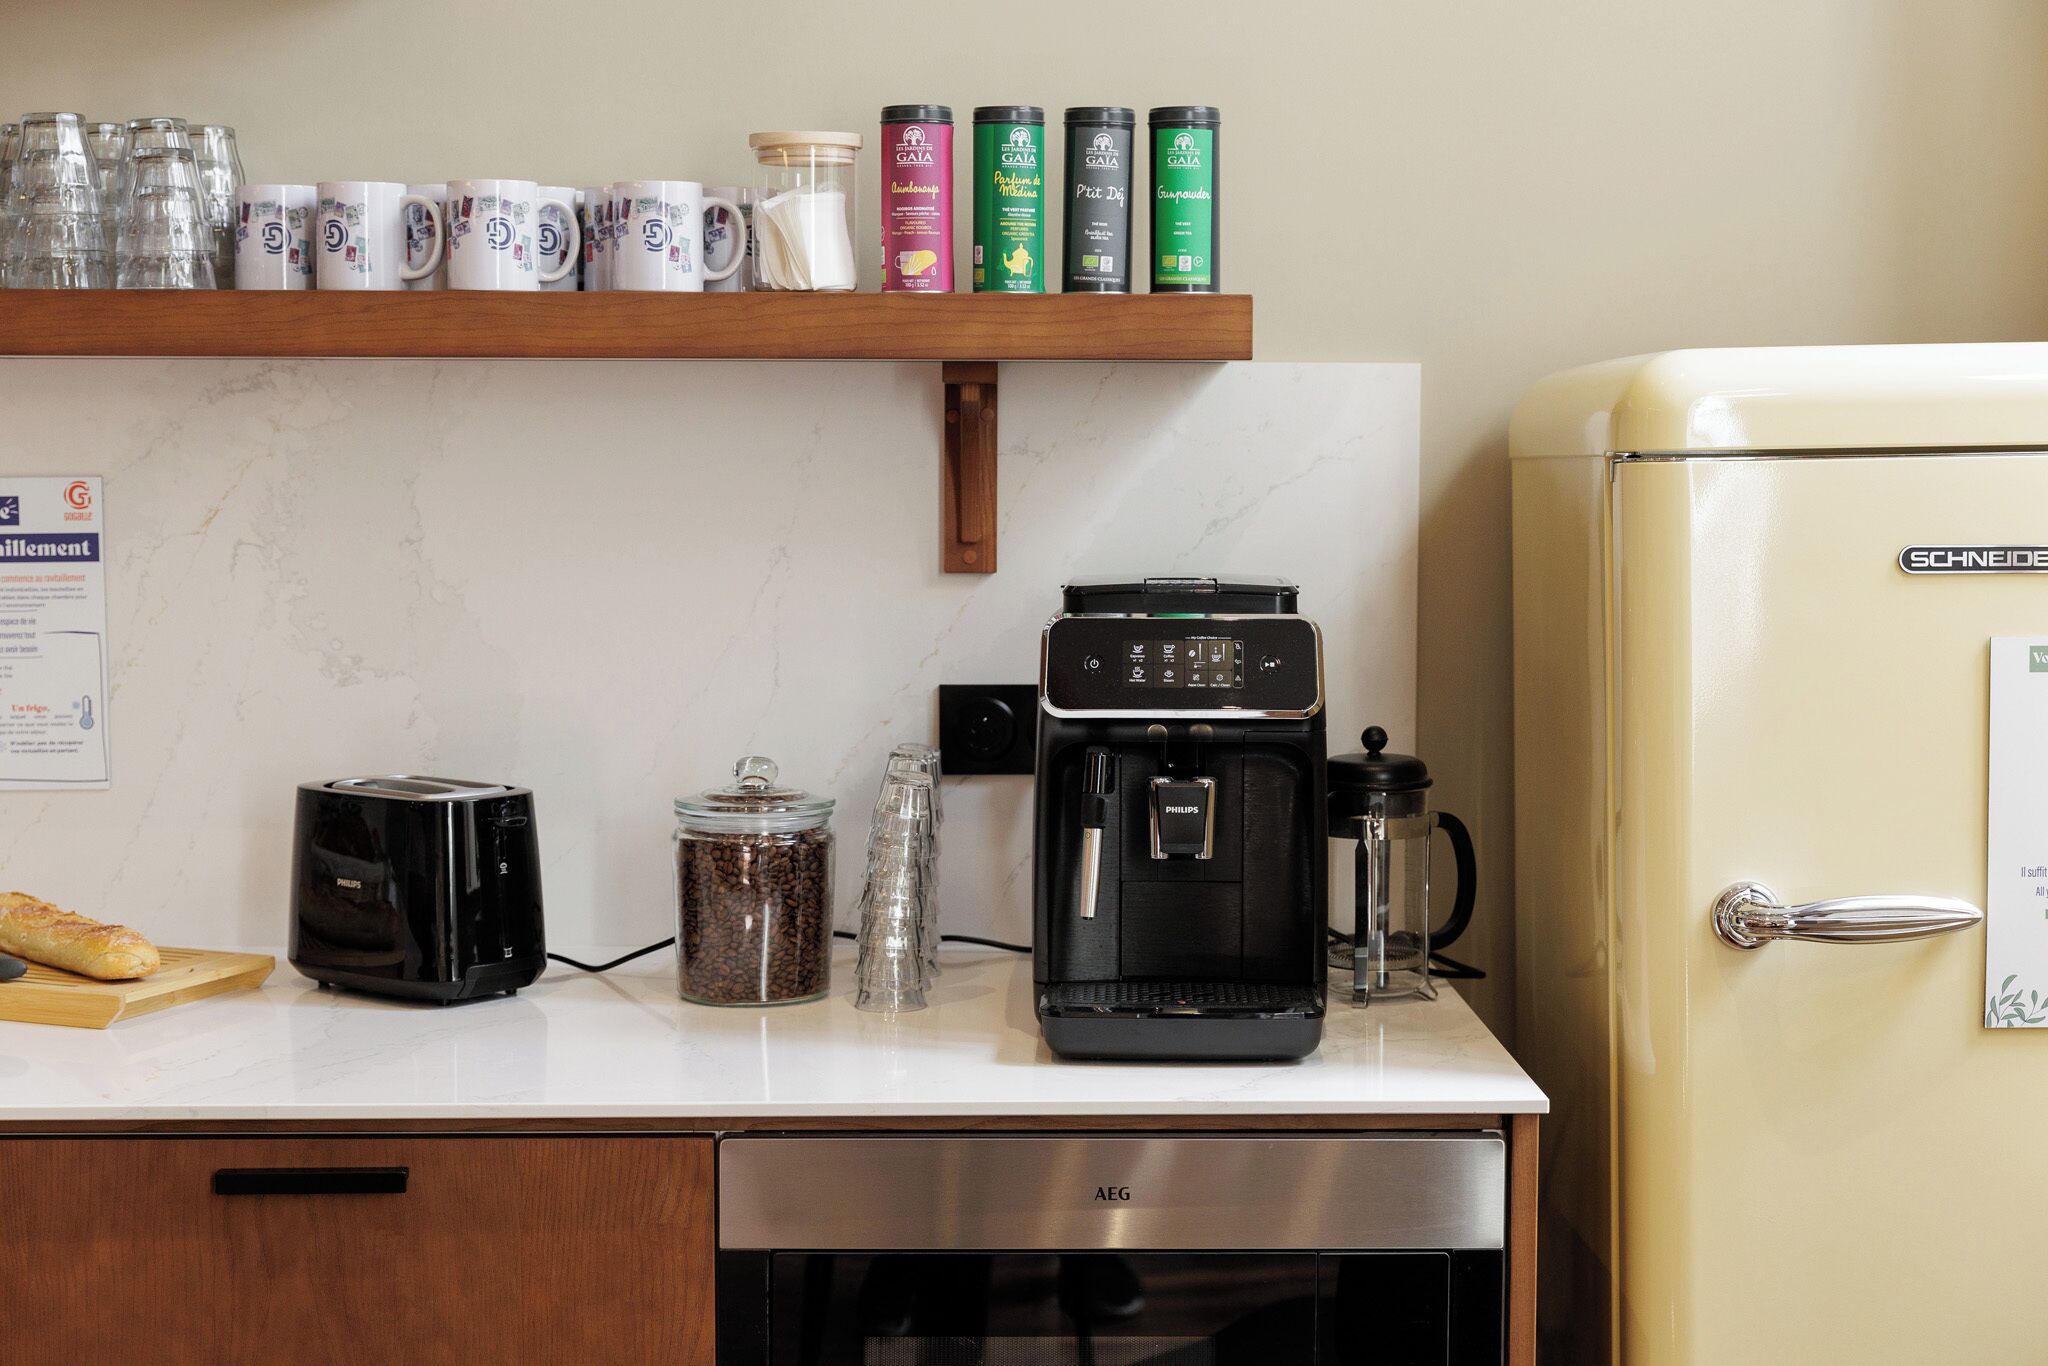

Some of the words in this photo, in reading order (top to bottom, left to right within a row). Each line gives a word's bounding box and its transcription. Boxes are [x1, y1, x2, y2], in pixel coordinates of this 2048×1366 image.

[896, 151, 933, 161] GAÏA
[1001, 152, 1037, 163] GAÏA
[1085, 154, 1118, 166] GAÏA
[1167, 154, 1200, 165] GAÏA
[994, 170, 1032, 188] Parfum
[1033, 173, 1041, 186] de
[999, 183, 1038, 198] Médina
[1076, 183, 1103, 199] P'tit
[1106, 186, 1125, 208] Déj
[1157, 185, 1211, 205] Gunpowder
[1165, 806, 1199, 814] PHILIPS
[2020, 866, 2026, 878] Il
[2027, 866, 2048, 878] suffit
[336, 878, 362, 889] PHILIPS
[2035, 886, 2045, 897] All
[1094, 1186, 1130, 1201] AEG
